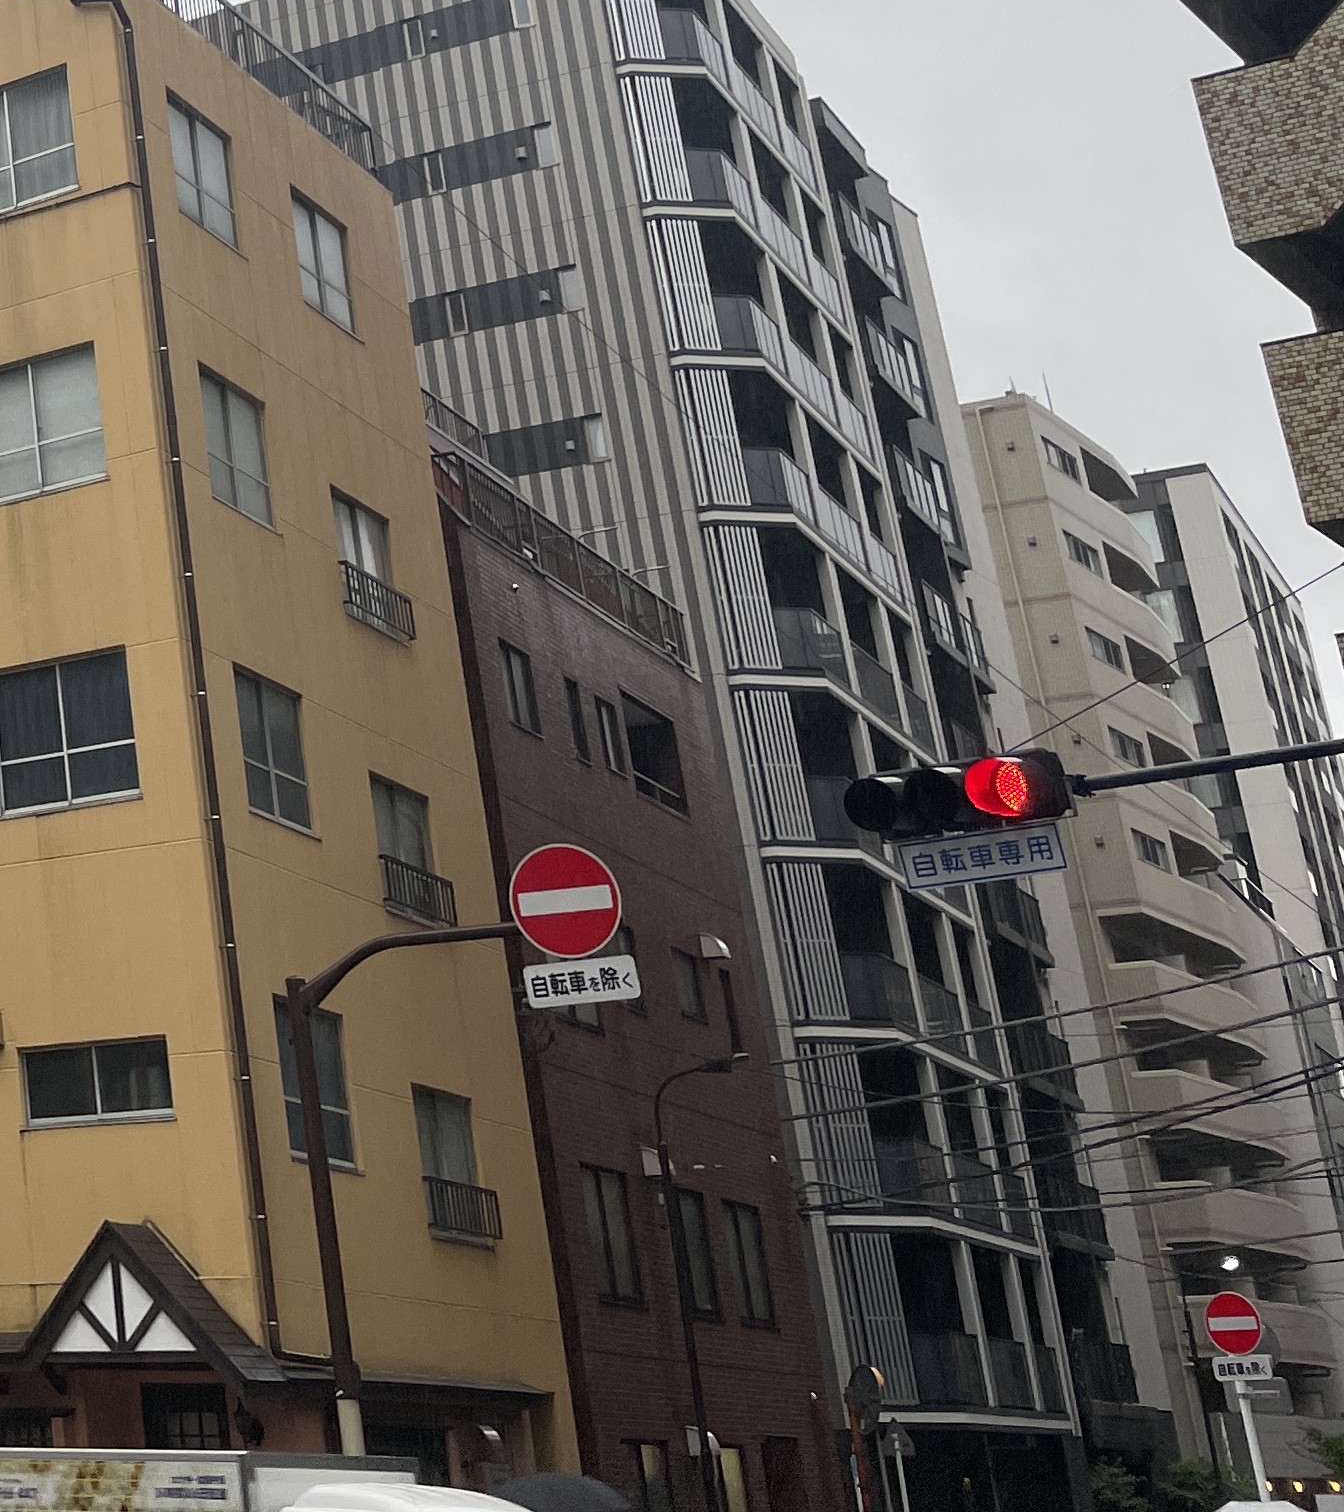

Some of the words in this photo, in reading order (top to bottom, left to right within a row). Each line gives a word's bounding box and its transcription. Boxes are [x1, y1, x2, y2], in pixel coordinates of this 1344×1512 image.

[912, 834, 1056, 878] 自転車専用
[531, 967, 634, 999] 自転車を除く
